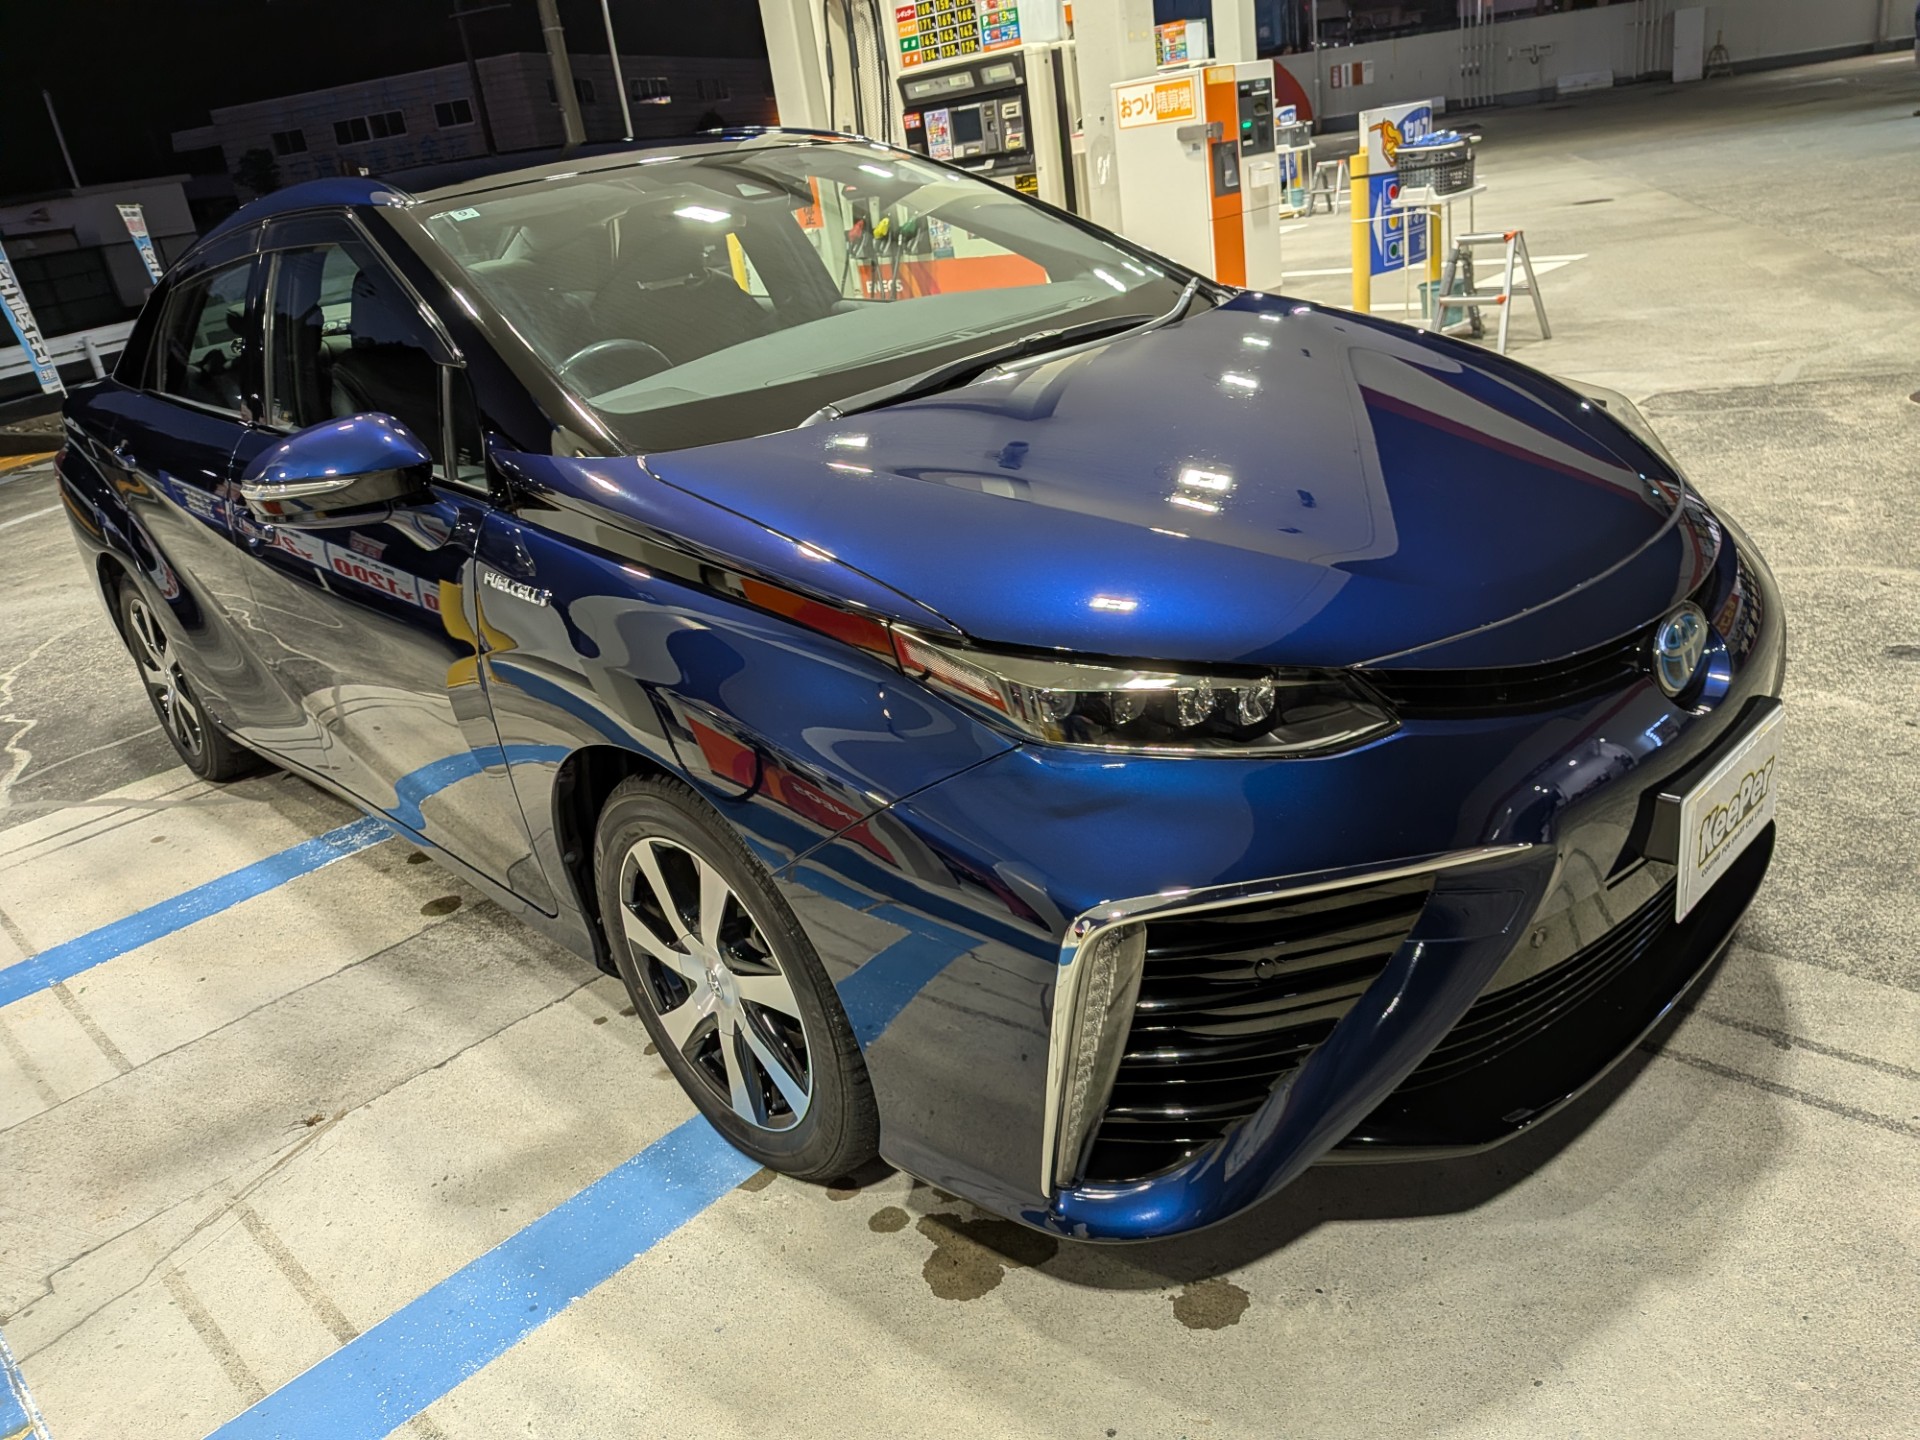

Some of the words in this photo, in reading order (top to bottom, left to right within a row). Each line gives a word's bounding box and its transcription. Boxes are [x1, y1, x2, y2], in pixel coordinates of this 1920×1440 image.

[918, 18, 932, 31] 171
[938, 13, 951, 26] 169
[984, 30, 990, 40] C
[942, 44, 955, 57] 133
[1698, 755, 1775, 868] KeePer
